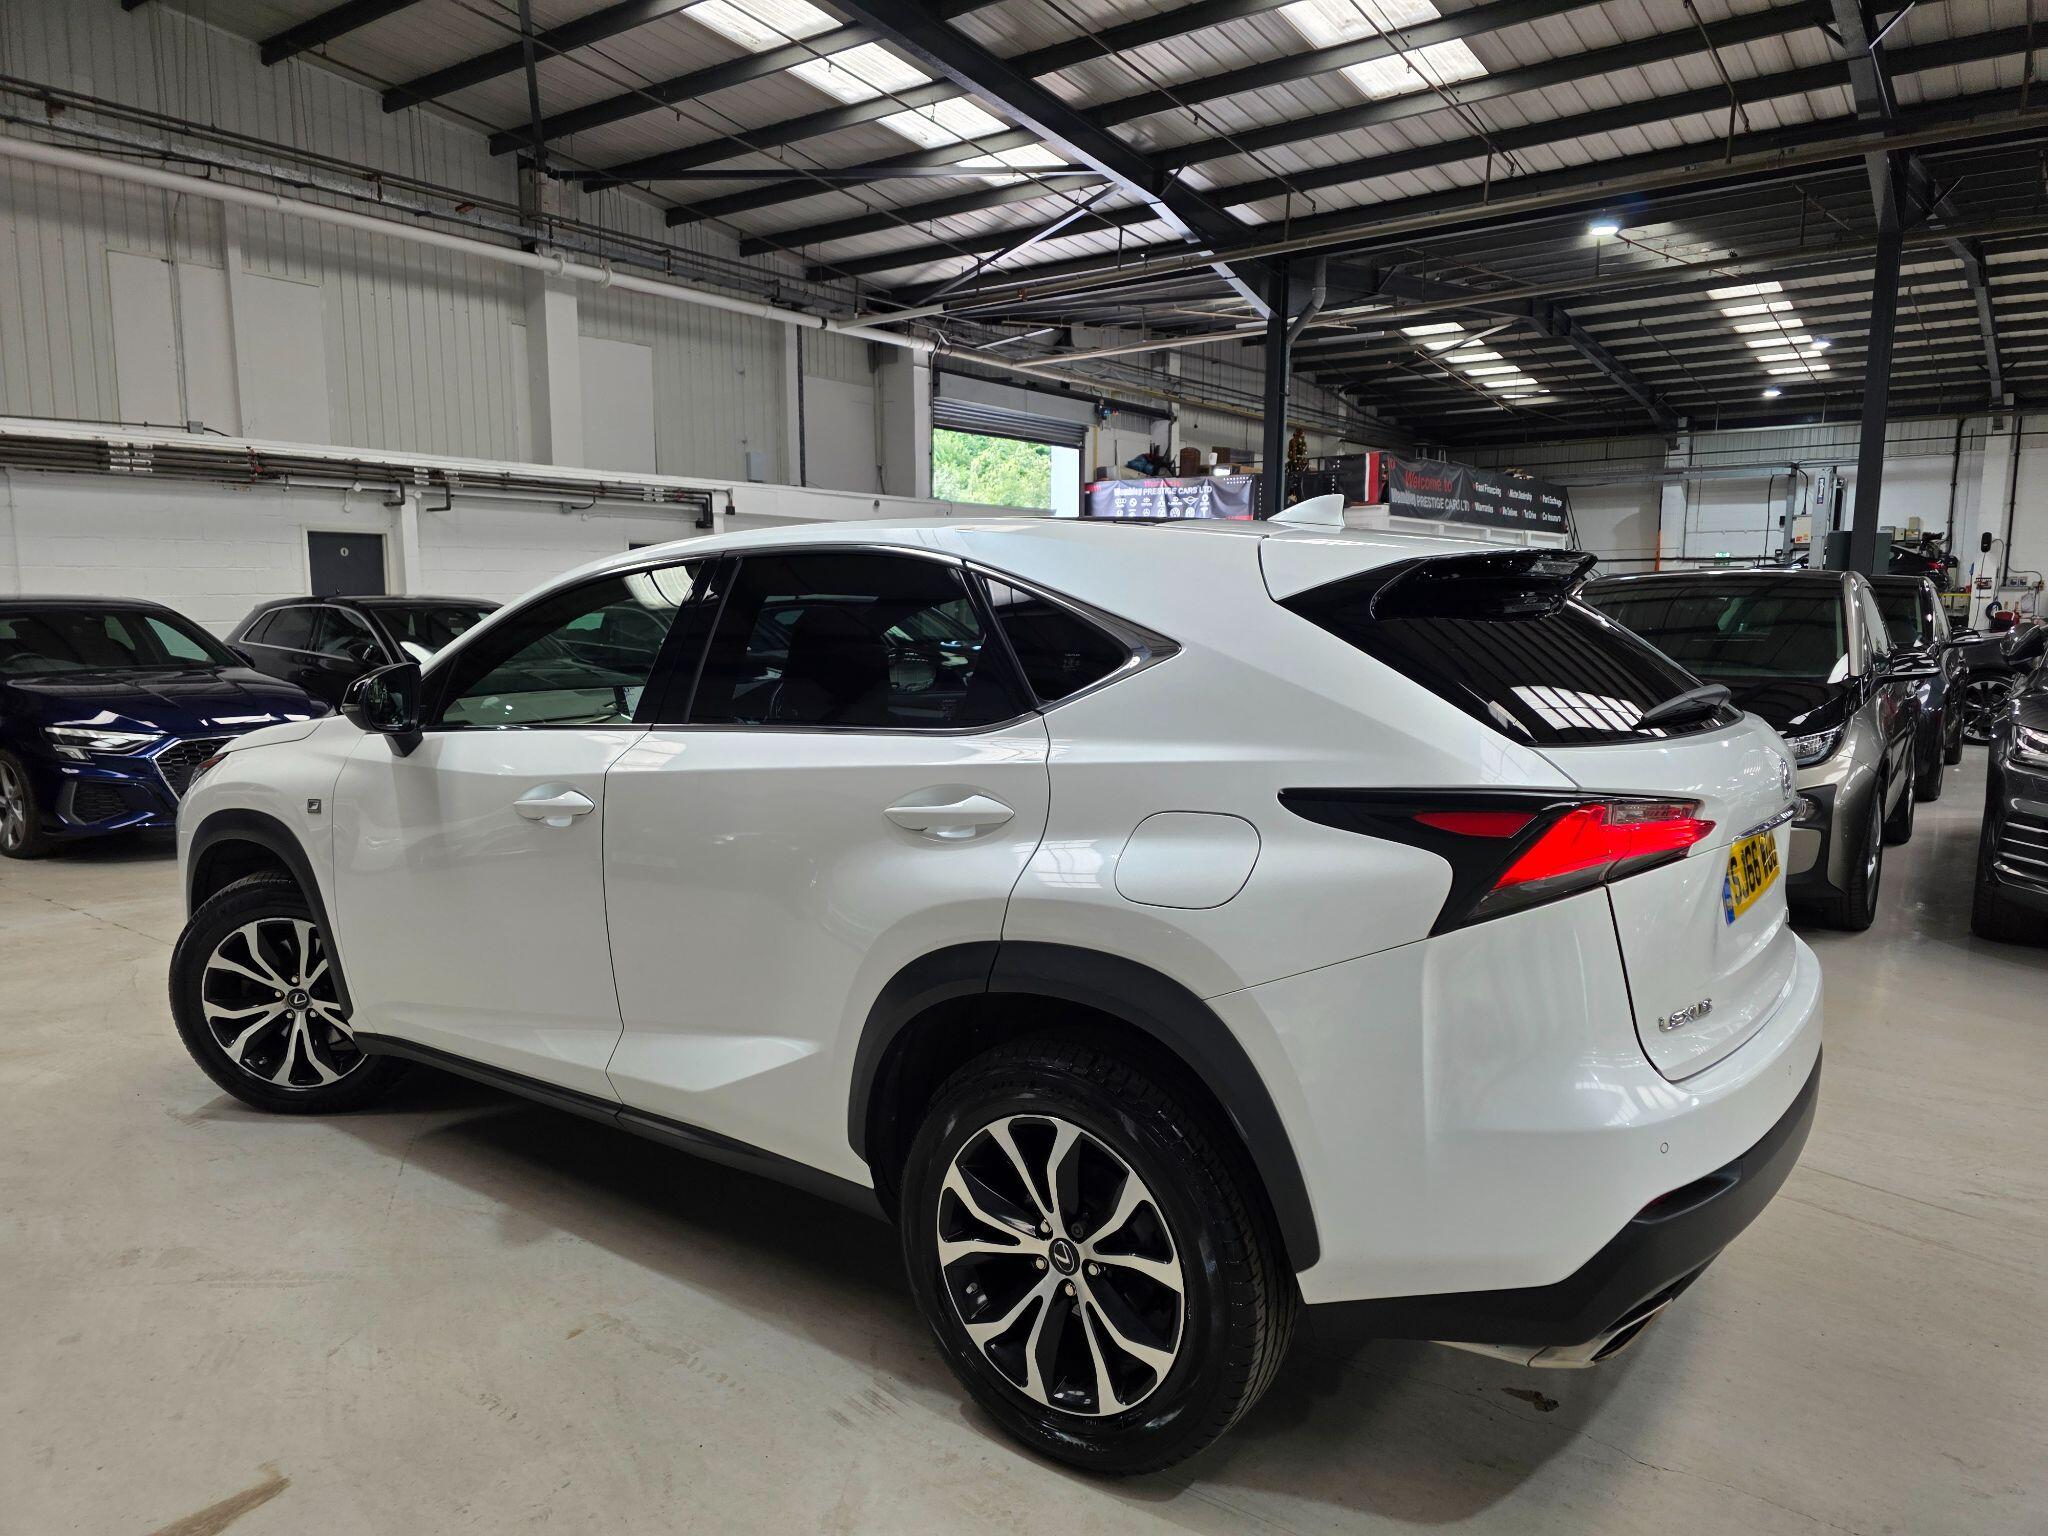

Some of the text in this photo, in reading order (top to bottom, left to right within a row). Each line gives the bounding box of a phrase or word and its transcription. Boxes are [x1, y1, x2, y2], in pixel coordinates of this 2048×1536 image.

[1143, 486, 1177, 496] PRESTIGE
[1178, 485, 1198, 495] CARS
[1199, 484, 1213, 494] LTD
[1405, 470, 1453, 493] Welcome to
[1416, 495, 1445, 510] PRESTIGE
[1445, 498, 1461, 512] CARS
